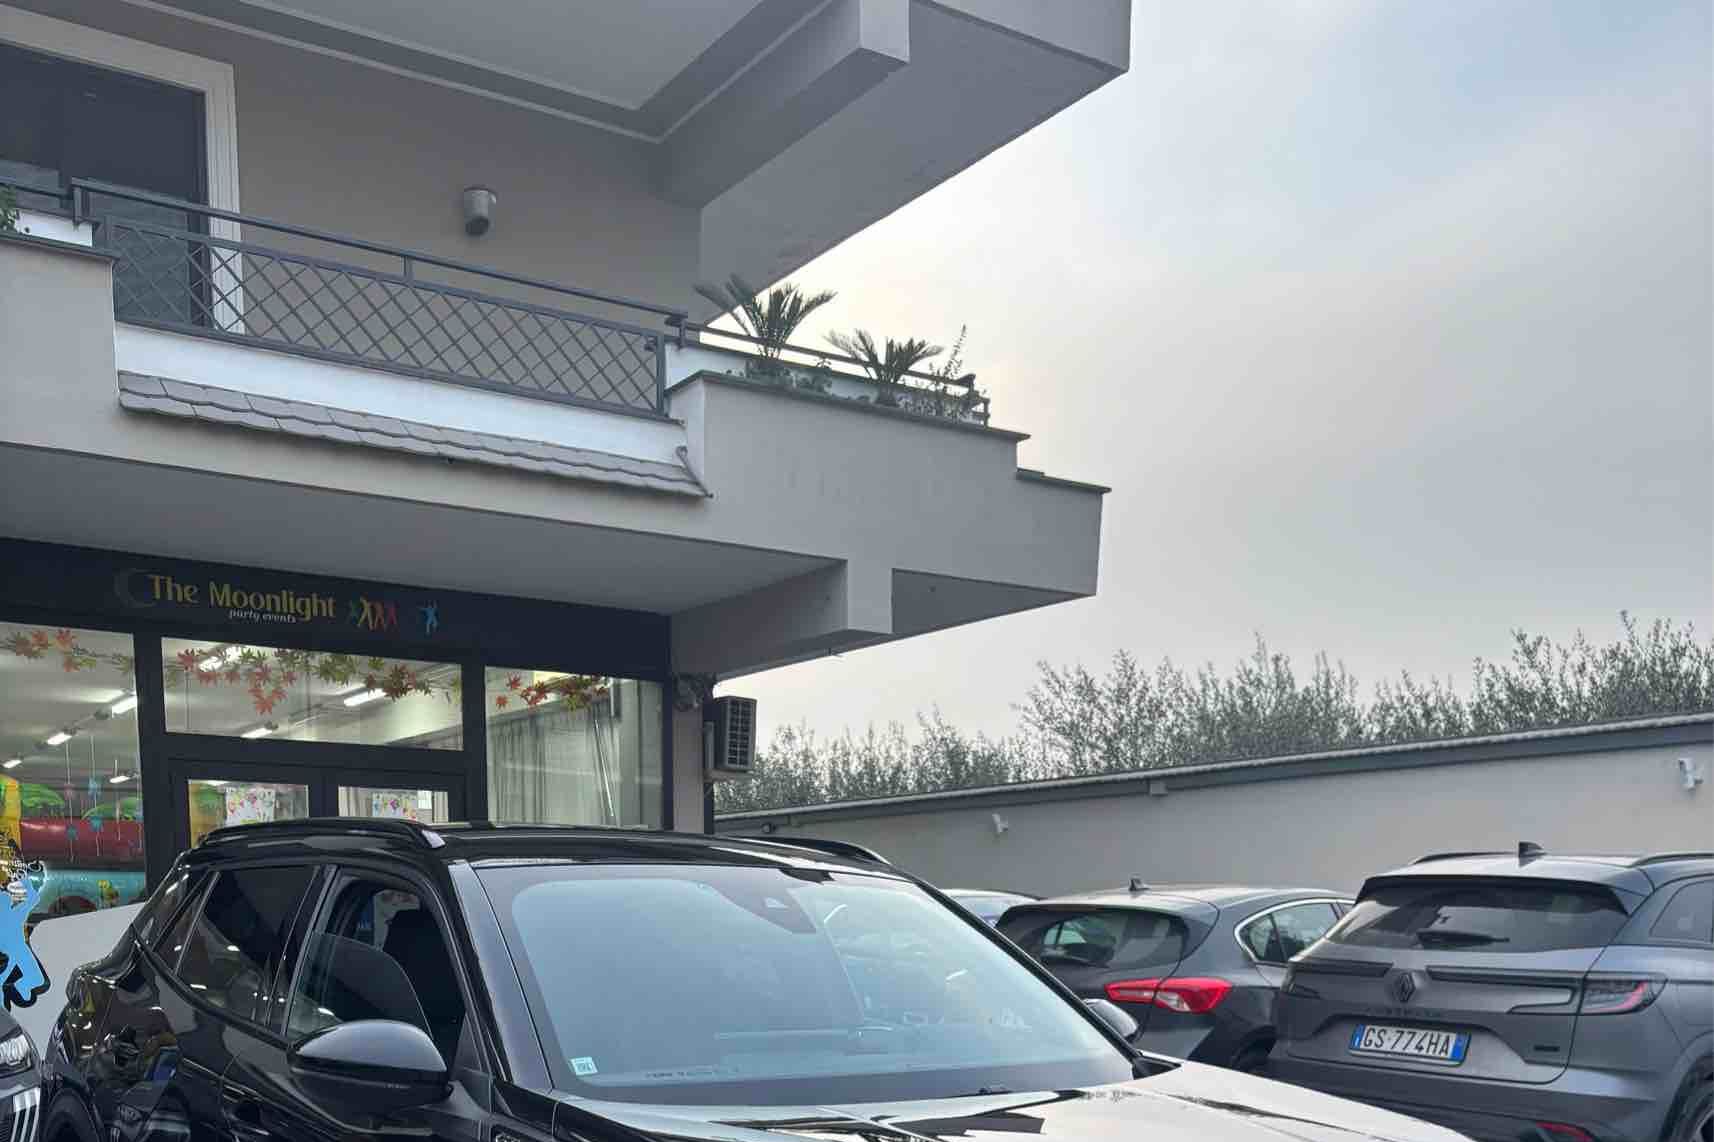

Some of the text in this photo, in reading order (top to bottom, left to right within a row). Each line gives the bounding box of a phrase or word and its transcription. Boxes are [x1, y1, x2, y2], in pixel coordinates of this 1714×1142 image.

[150, 574, 336, 622] The Moonlight
[229, 608, 297, 624] party events
